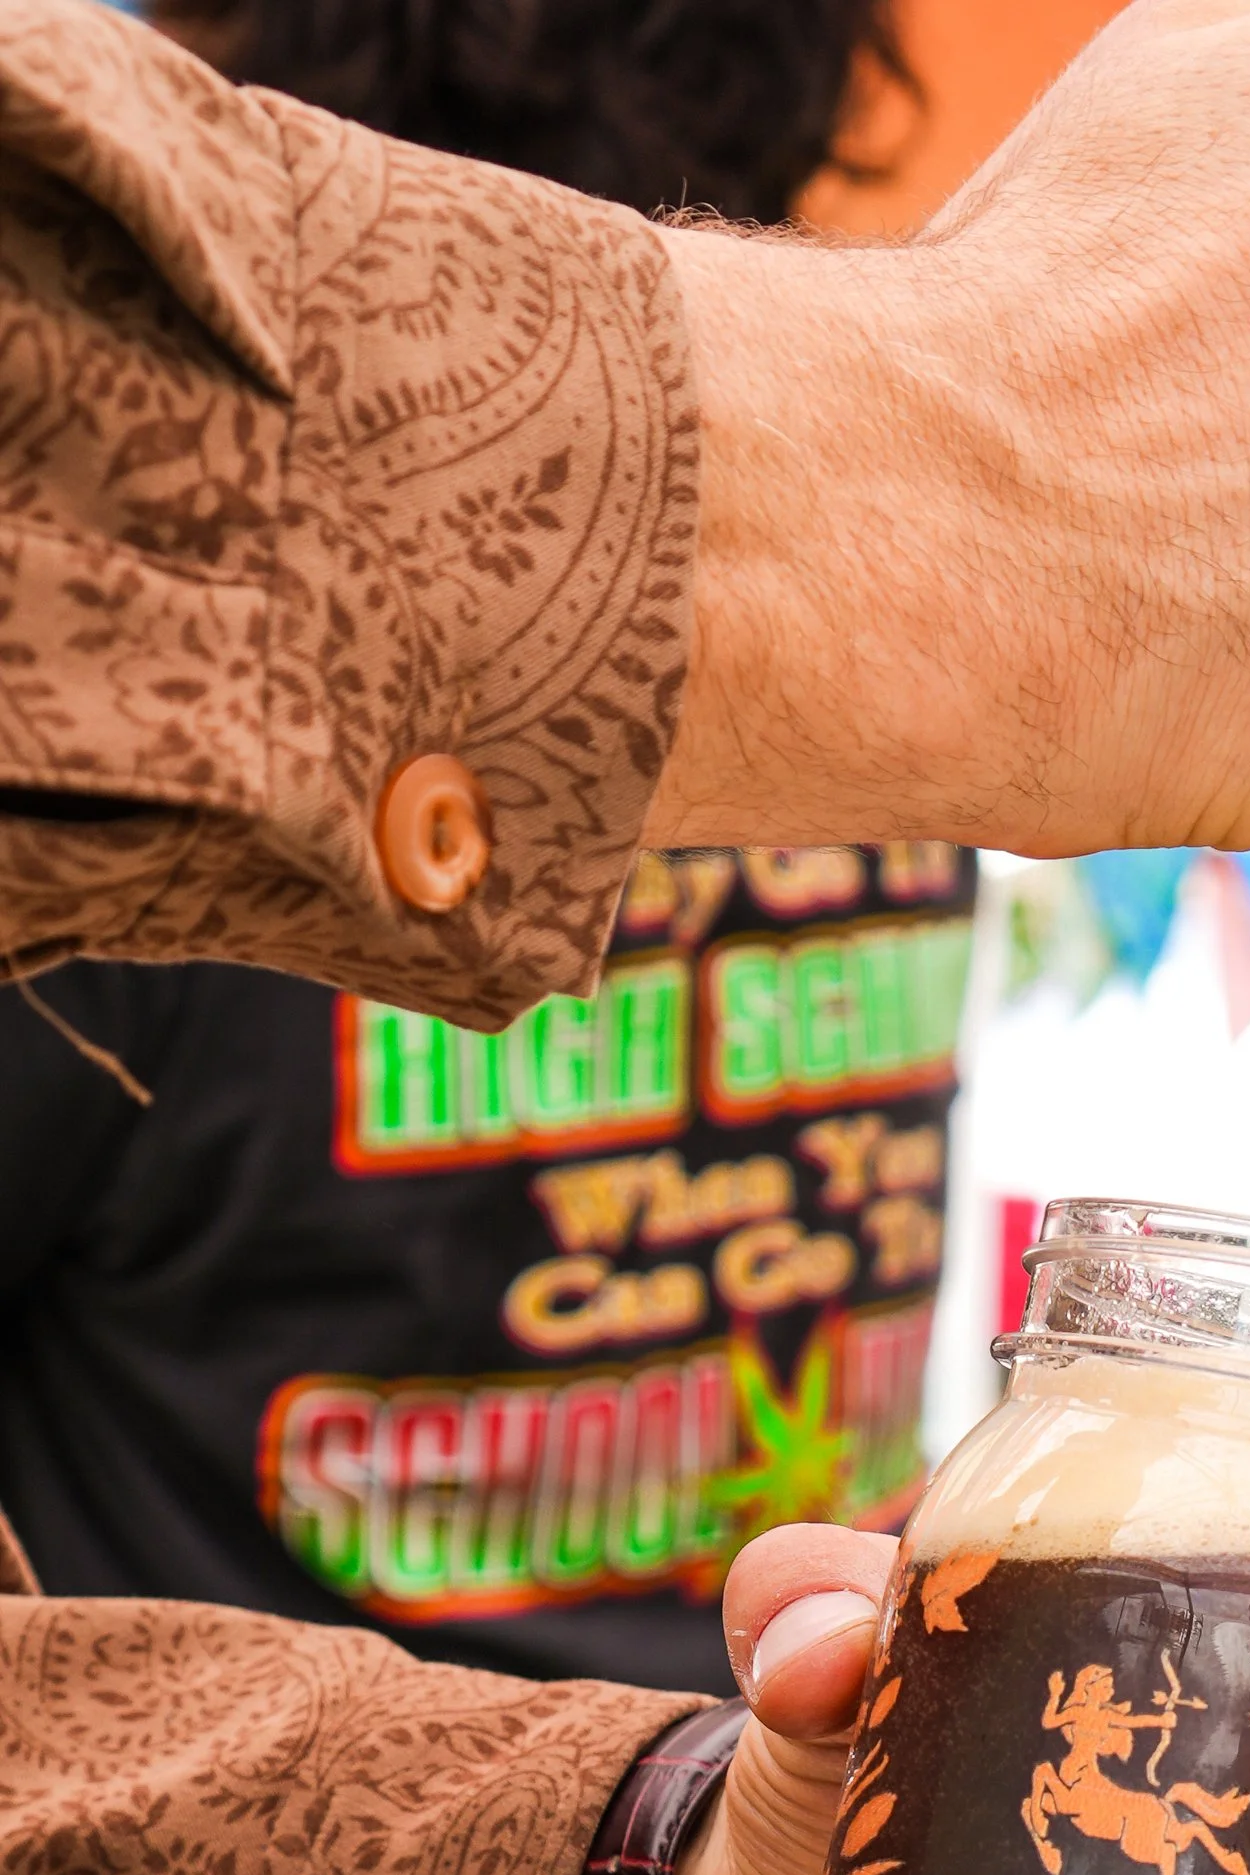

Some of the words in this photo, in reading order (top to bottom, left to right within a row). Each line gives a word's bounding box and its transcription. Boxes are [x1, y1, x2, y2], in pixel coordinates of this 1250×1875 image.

[345, 952, 692, 1160] HIGH
[712, 920, 972, 1105] SCH
[503, 1253, 708, 1357] Can
[275, 1350, 740, 1605] SCHOOL
